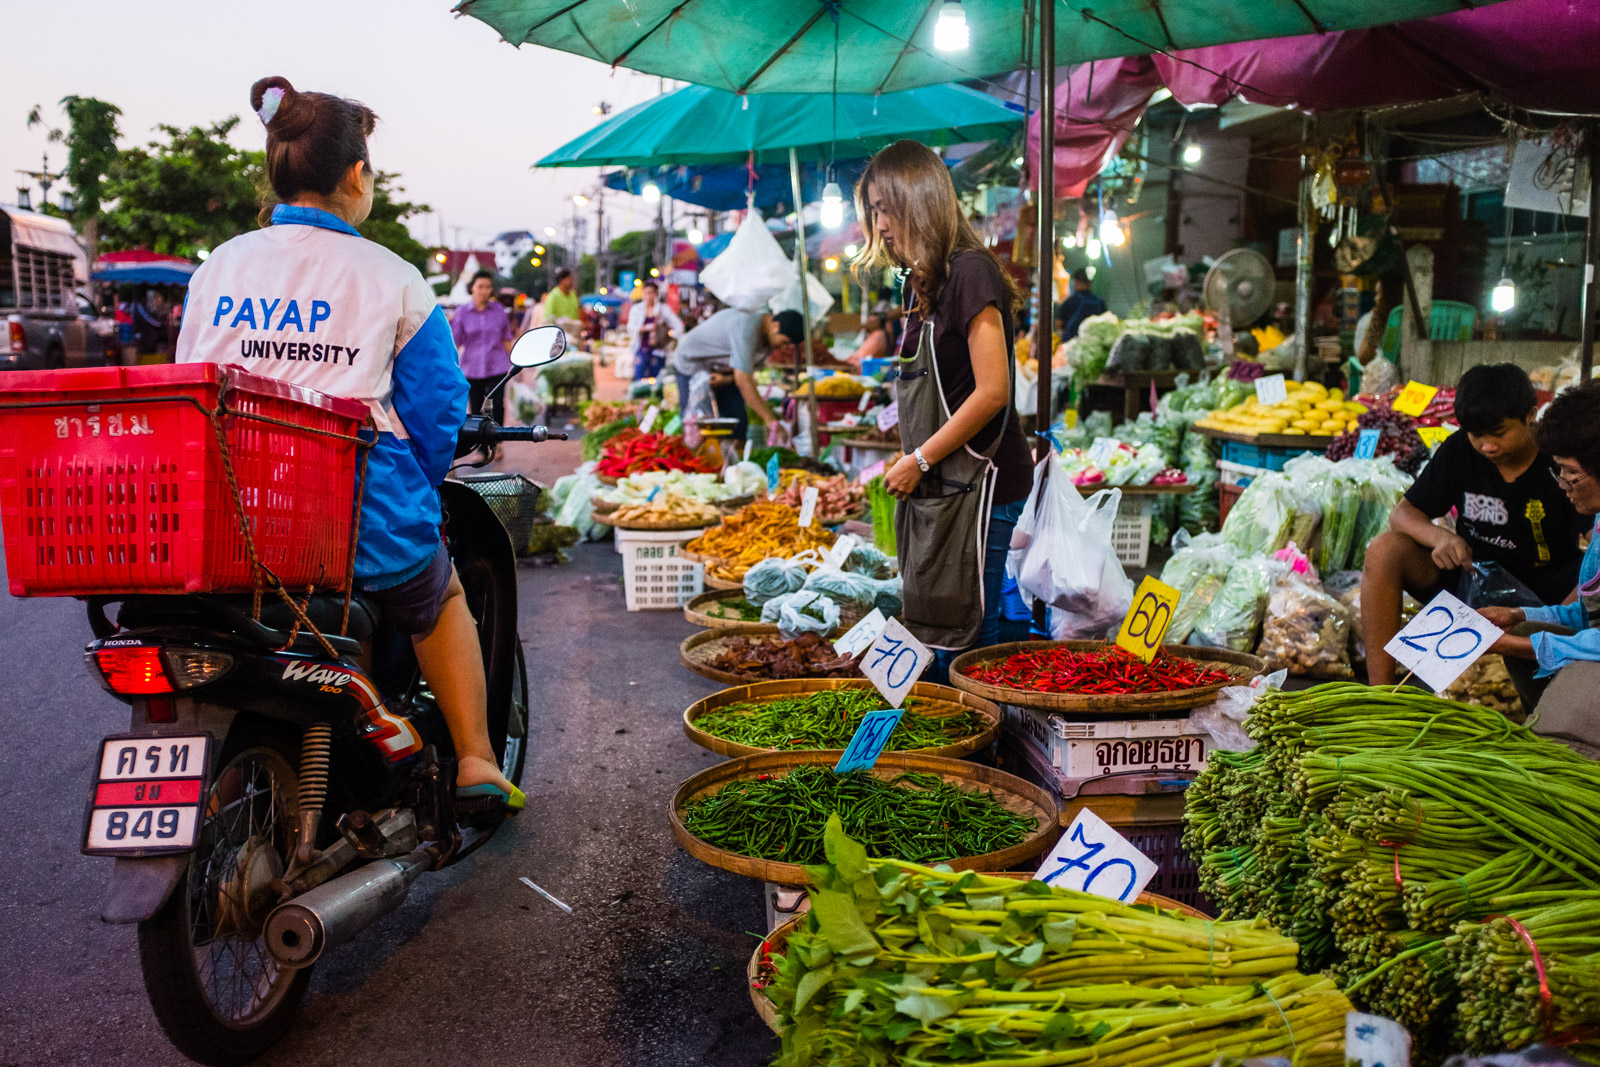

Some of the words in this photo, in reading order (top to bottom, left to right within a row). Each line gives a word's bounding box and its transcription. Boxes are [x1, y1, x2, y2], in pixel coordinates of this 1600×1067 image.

[213, 296, 331, 333] PAYAP
[241, 339, 360, 366] UNIVERSITY
[1463, 505, 1509, 526] BAND
[1464, 491, 1507, 512] ROCK
[1128, 592, 1170, 649] 60
[1399, 606, 1482, 659] 20
[281, 660, 351, 685] Wave
[871, 635, 918, 689] 70
[319, 684, 342, 694] 100
[847, 715, 898, 764] 150
[106, 809, 179, 840] 849
[1042, 822, 1137, 901] 70
